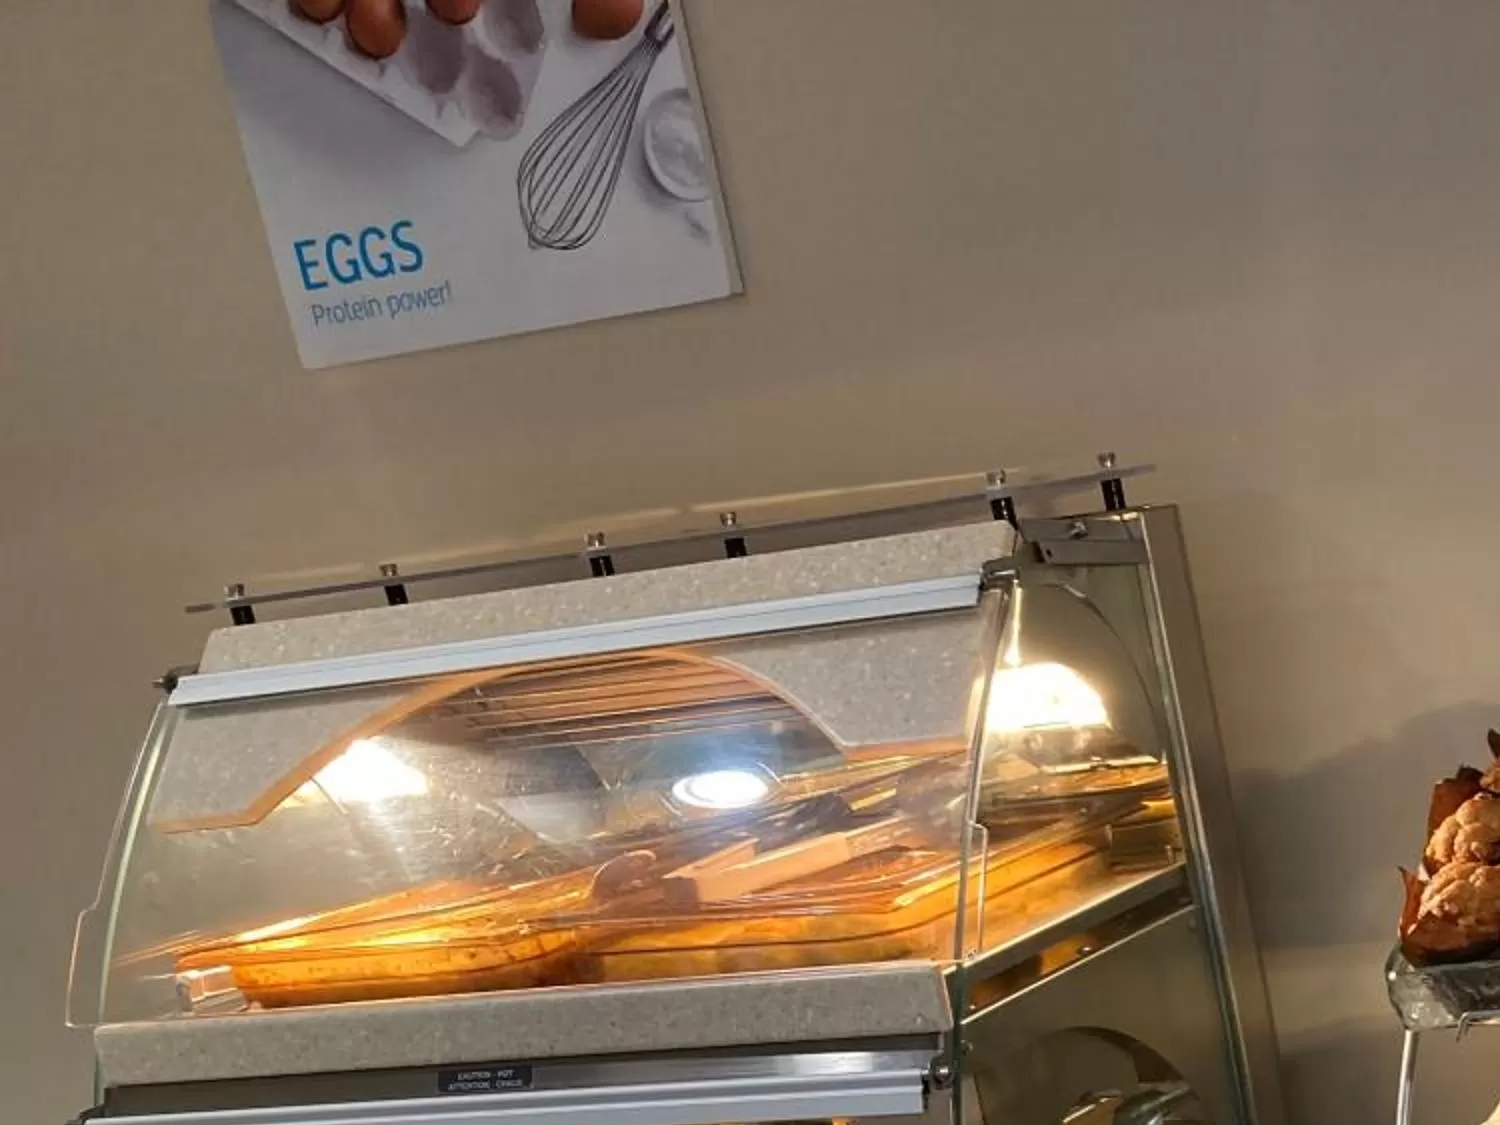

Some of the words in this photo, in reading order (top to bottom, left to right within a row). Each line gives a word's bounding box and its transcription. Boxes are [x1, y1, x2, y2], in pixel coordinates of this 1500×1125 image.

[293, 220, 423, 290] EGGS
[311, 296, 383, 327] Protein
[386, 280, 452, 320] power!
